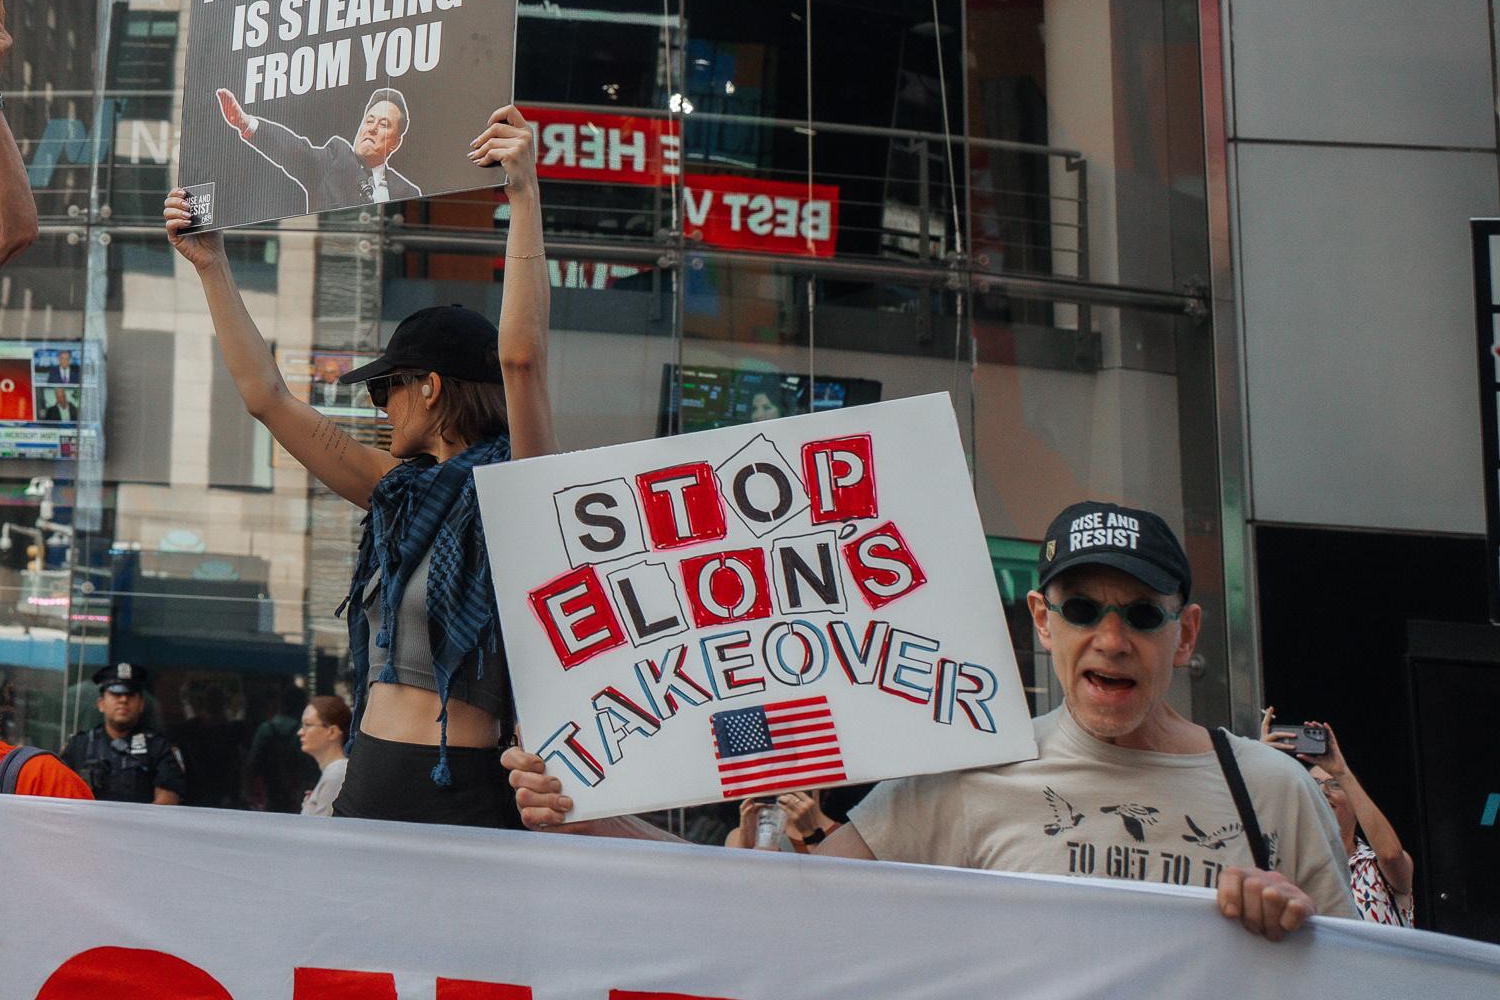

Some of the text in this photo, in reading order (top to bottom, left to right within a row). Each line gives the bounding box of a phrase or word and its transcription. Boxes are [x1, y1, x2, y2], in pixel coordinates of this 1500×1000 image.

[232, 0, 269, 51] IS
[244, 21, 443, 104] FROM YOU
[190, 203, 210, 216] SIST
[199, 194, 211, 204] AND
[574, 449, 866, 553] STOP
[1070, 512, 1140, 532] RISE AND
[1069, 528, 1140, 552] RESIST
[545, 521, 914, 655] ELON'S
[537, 619, 999, 788] TAKEOVER
[1067, 841, 1095, 875] TO
[1106, 845, 1150, 881] GET
[1161, 852, 1191, 886] TO
